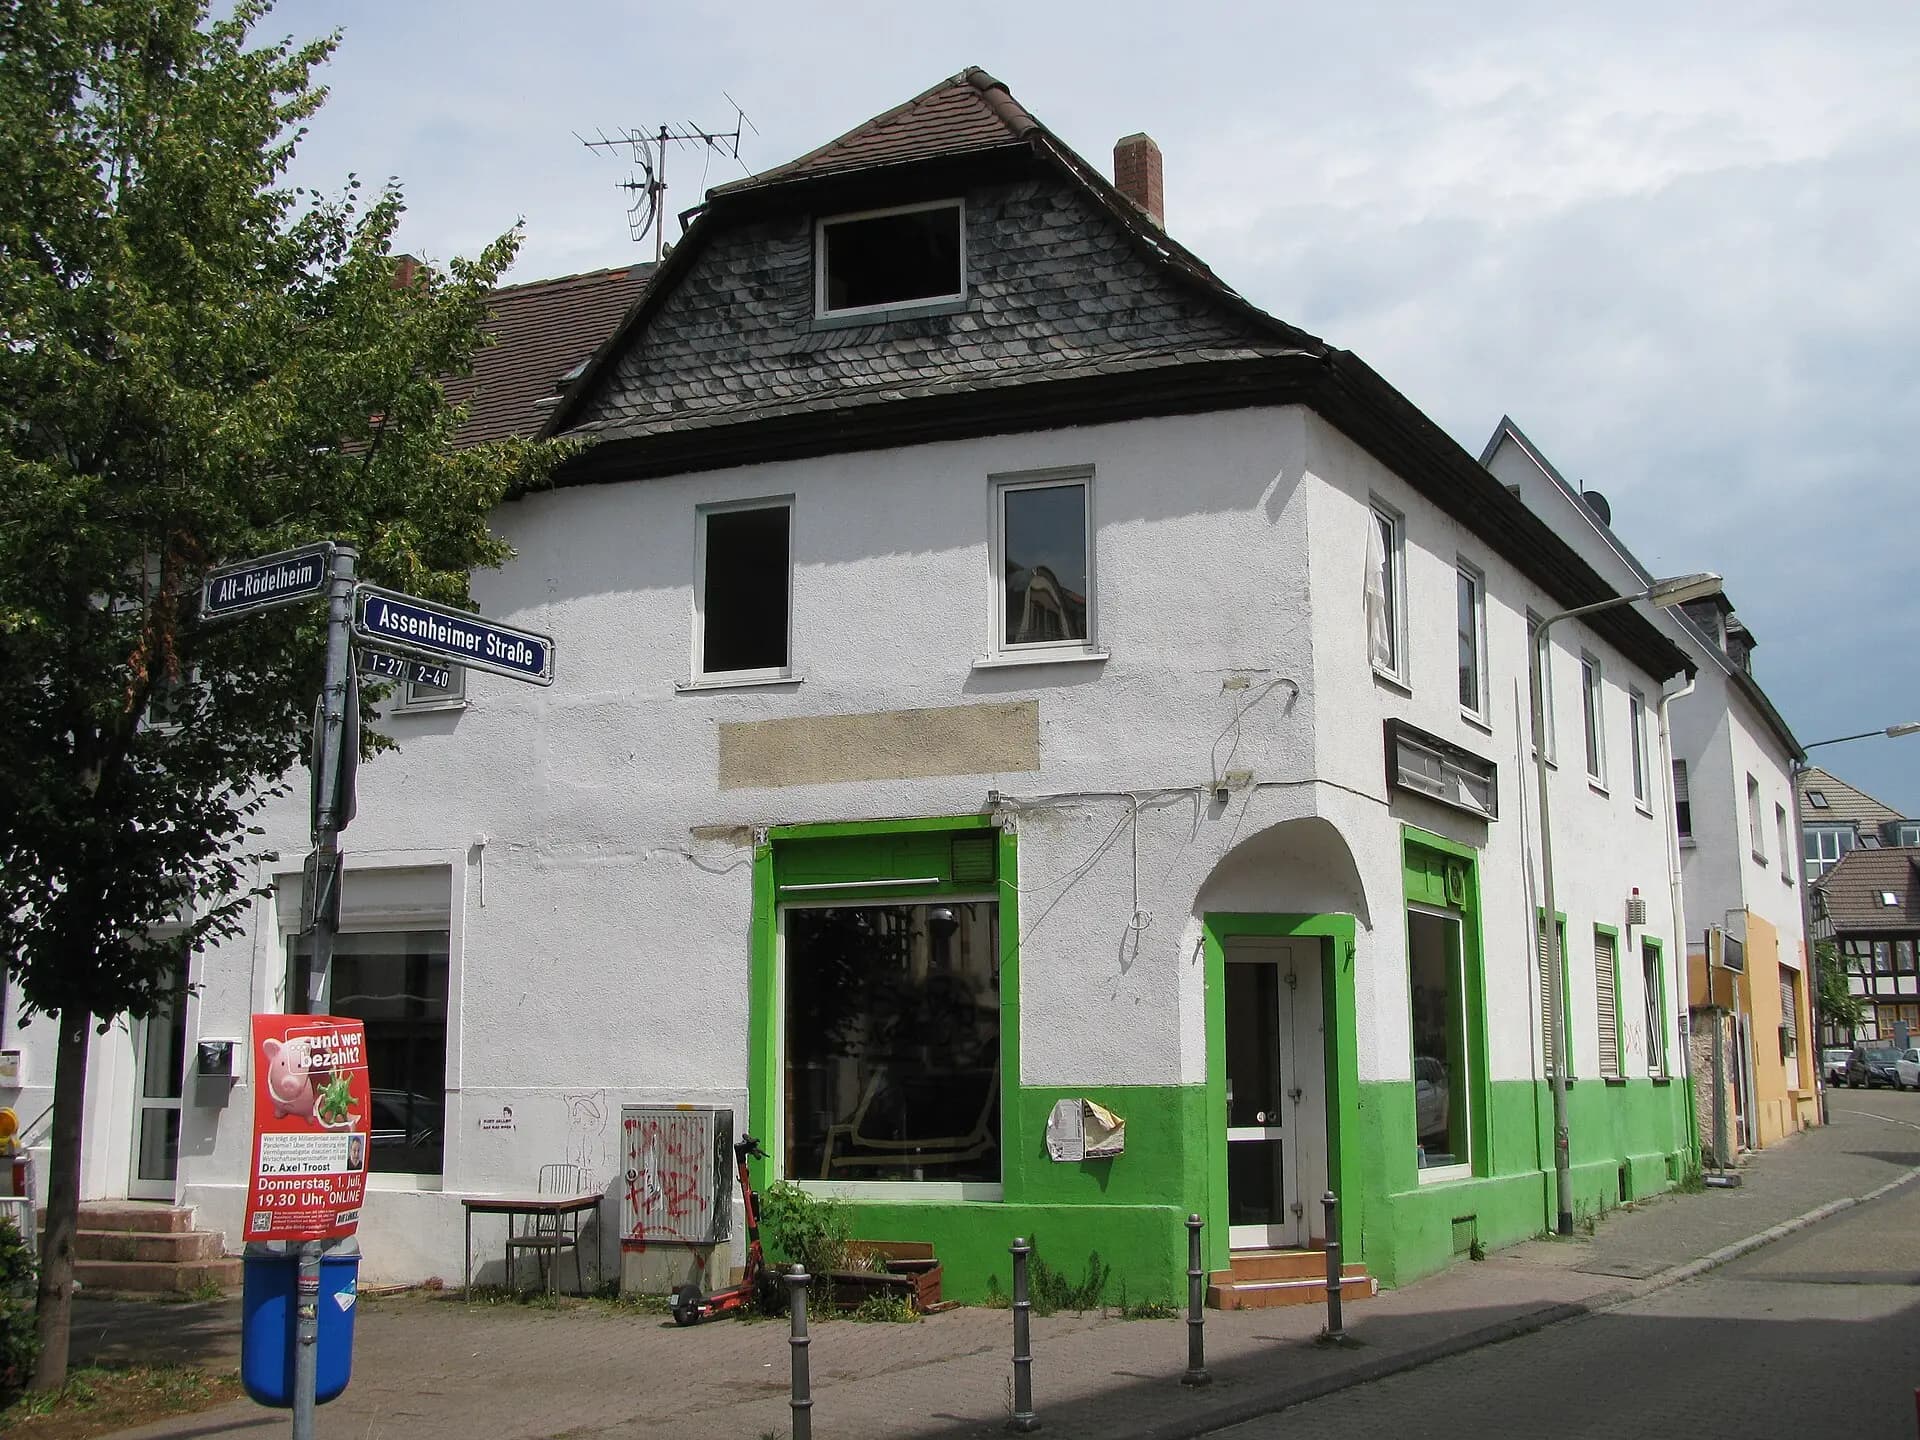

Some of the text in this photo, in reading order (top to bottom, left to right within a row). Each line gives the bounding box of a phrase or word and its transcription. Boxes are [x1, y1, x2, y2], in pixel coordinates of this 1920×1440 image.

[218, 562, 313, 603] Alt-Rödelheim
[378, 603, 533, 666] Assenheimer Straße
[372, 654, 404, 677] 1-27
[417, 665, 449, 688] 2-40
[73, 1029, 82, 1043] 6
[340, 1032, 362, 1047] wer
[301, 1046, 359, 1067] bezahlt?
[262, 1163, 330, 1173] Dr. Axel Troost
[258, 1174, 362, 1191] Donnerstag, 1. Juli,
[258, 1190, 361, 1208] 19.30 Uhr, ONLINE
